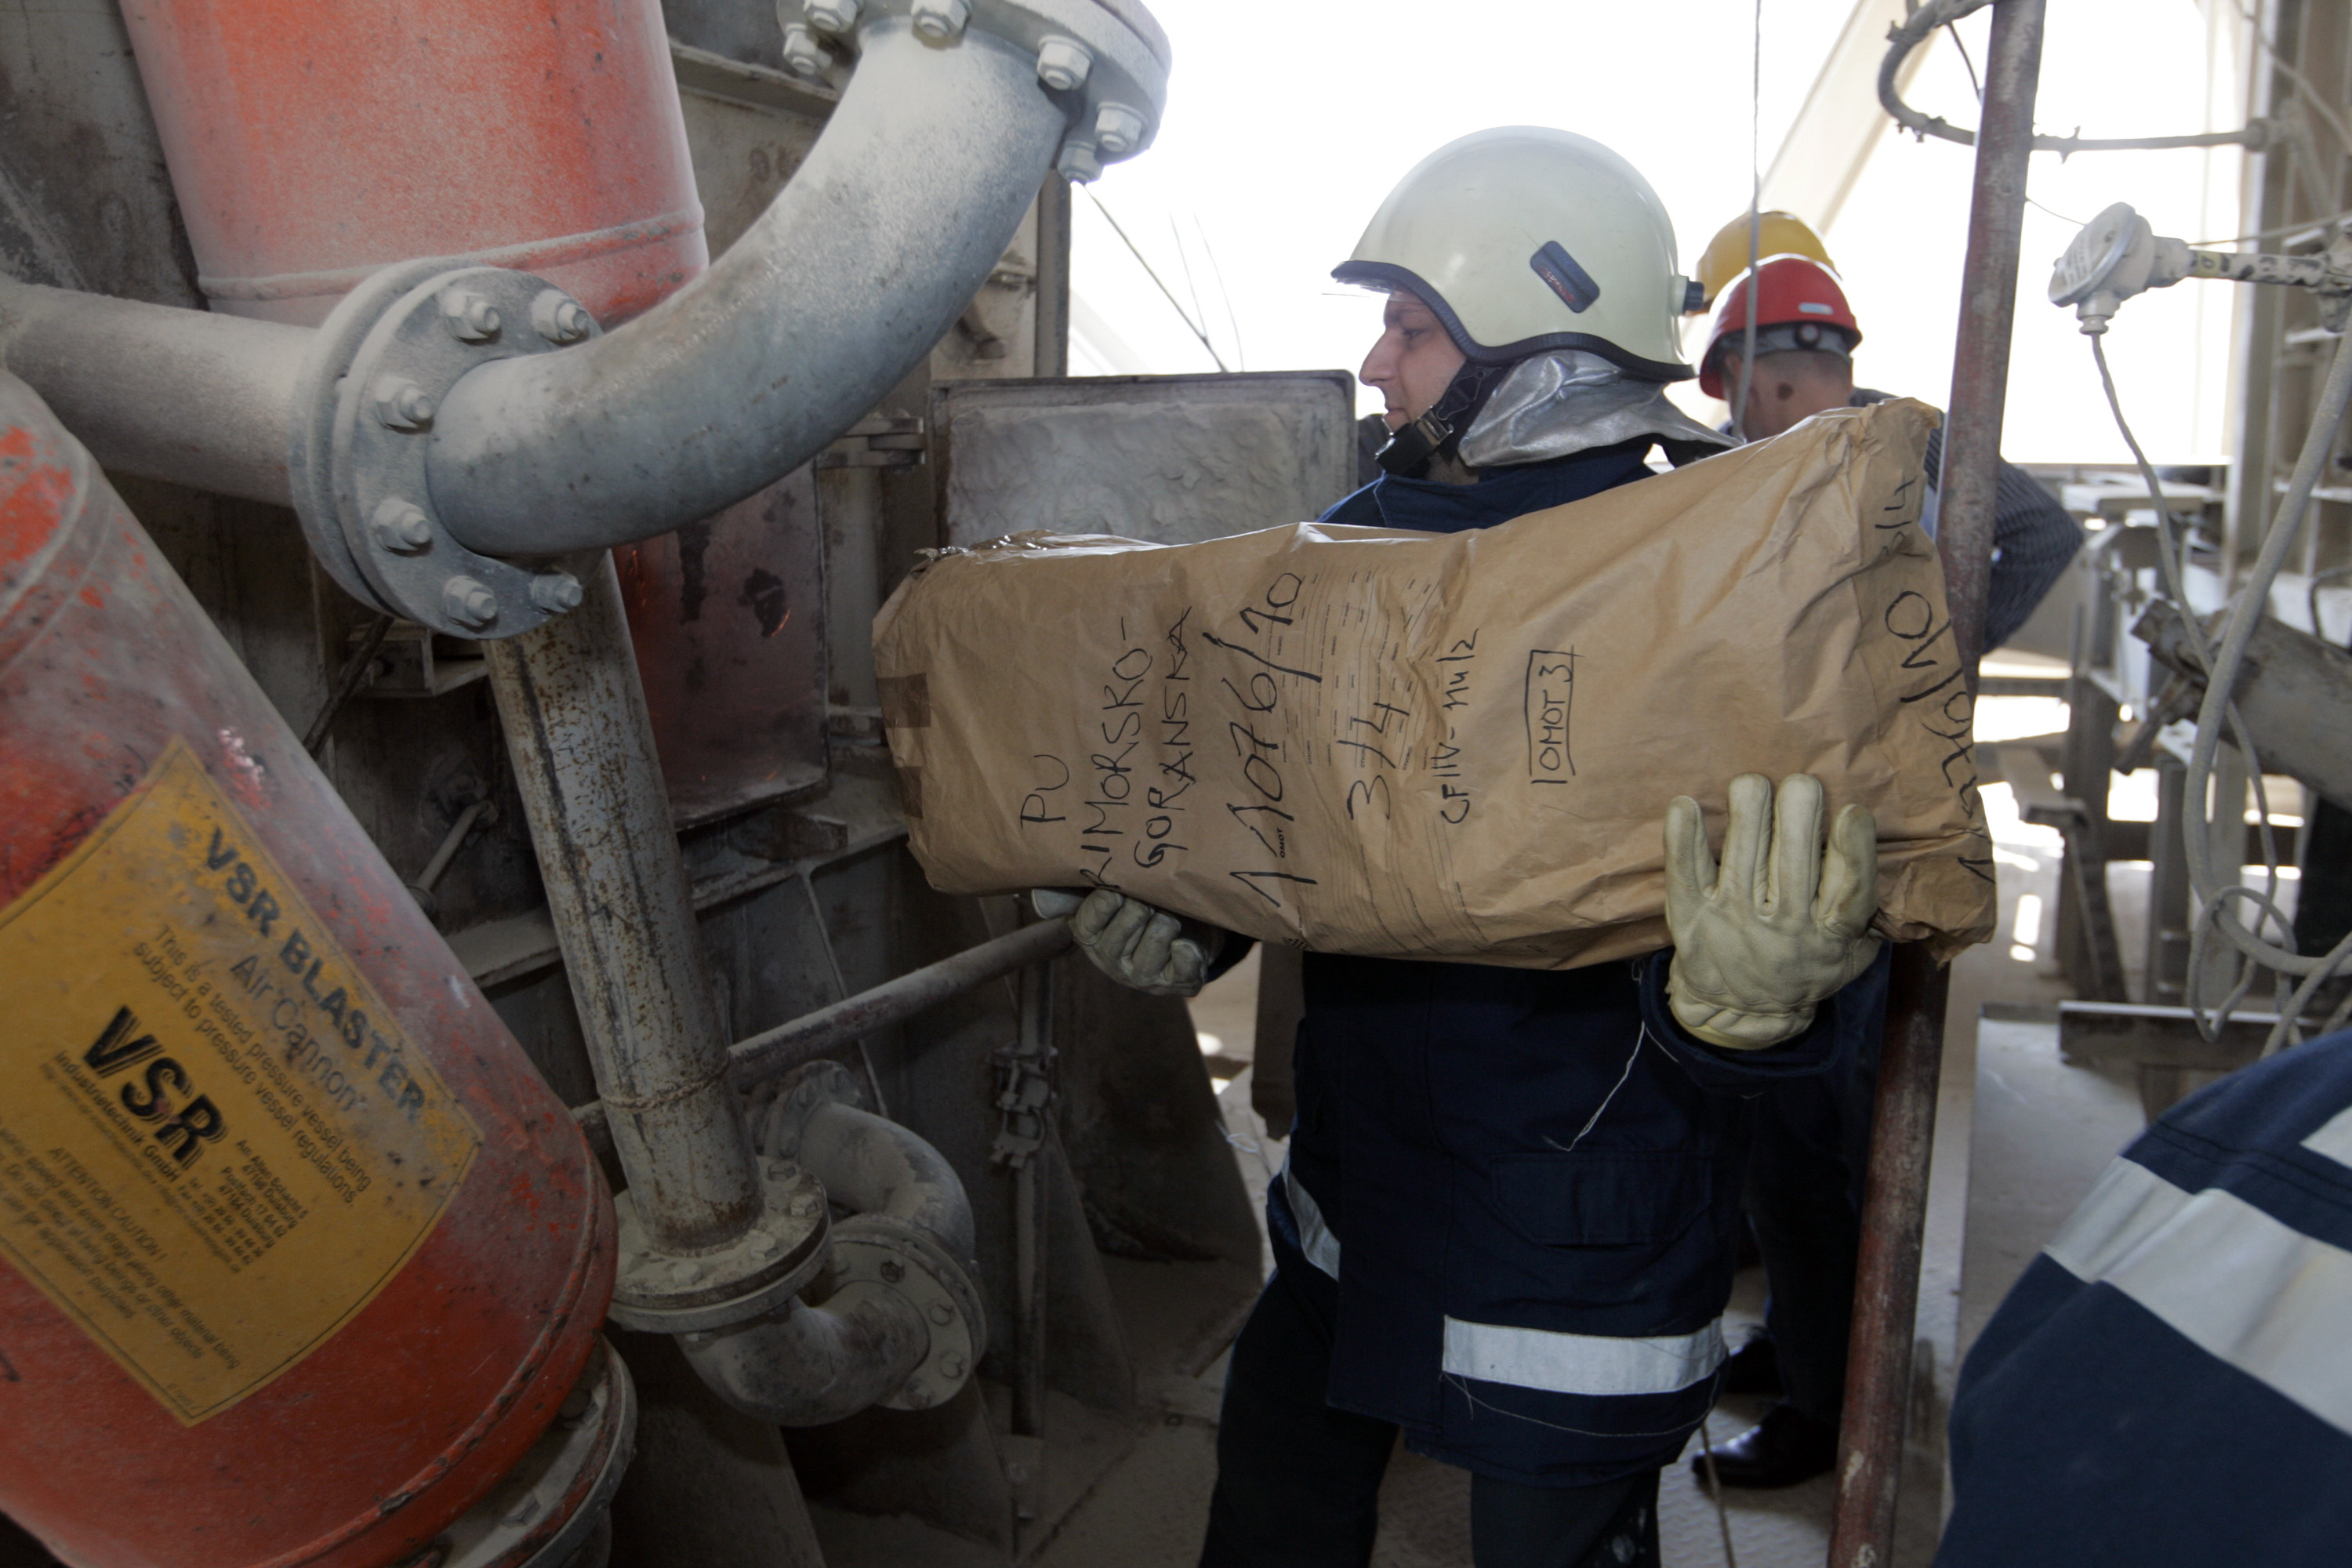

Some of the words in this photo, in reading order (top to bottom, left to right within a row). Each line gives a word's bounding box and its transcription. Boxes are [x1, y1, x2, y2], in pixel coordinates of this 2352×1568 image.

[1538, 664, 1572, 682] 3
[1538, 689, 1566, 771] OMOT
[1020, 754, 1069, 829] PU
[1134, 606, 1195, 868] GORANSKA
[1336, 702, 1411, 821] 3/4
[1277, 827, 1286, 858] OMOT
[191, 825, 292, 939] VSR
[272, 927, 434, 1126] BLASTER
[228, 950, 279, 1002] Air
[263, 993, 370, 1115] Cannon
[74, 1004, 235, 1171] VSR
[128, 938, 191, 1006] subject
[181, 996, 205, 1021] to
[193, 1017, 259, 1090] pressure
[251, 1081, 299, 1133] vessel
[285, 1126, 364, 1212] regulations.
[151, 924, 192, 967] This
[180, 960, 205, 985] is
[194, 980, 213, 998] a
[205, 991, 256, 1046] tested
[243, 1040, 307, 1111] pressure
[298, 1102, 345, 1153] vessel
[331, 1146, 376, 1193] being
[47, 1142, 118, 1212] ATTENTION
[108, 1203, 163, 1258] CAUTION
[141, 1141, 183, 1184] GmbH
[260, 1187, 300, 1230] Duisburg
[57, 1184, 85, 1212] and
[154, 1280, 185, 1313] other
[178, 1304, 220, 1346] material
[211, 1339, 242, 1372] being
[239, 1207, 278, 1250] Duisburg
[168, 1322, 206, 1363] objects
